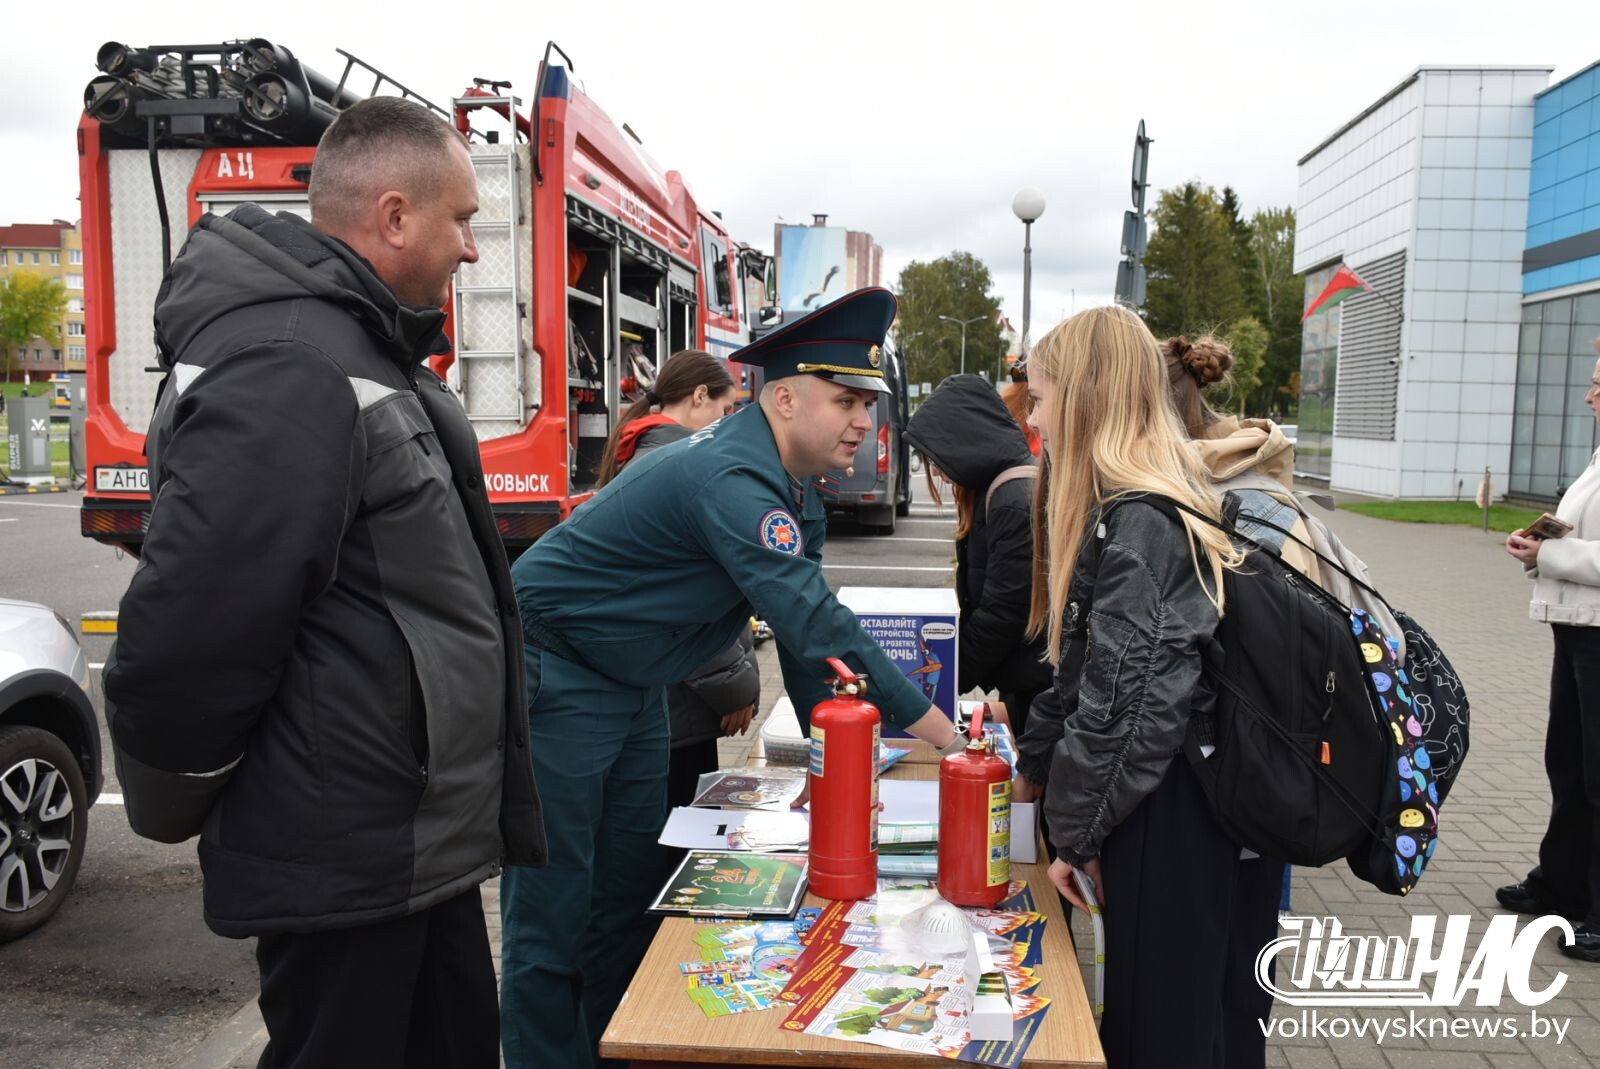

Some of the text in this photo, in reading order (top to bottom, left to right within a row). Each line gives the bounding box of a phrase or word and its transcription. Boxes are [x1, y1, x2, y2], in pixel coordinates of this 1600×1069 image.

[217, 152, 254, 180] АЦ
[484, 473, 549, 492] КОВЫСК
[860, 617, 917, 629] ОСТАВЛЯЙТЕ
[886, 640, 917, 649] РОЗЕТКУ,
